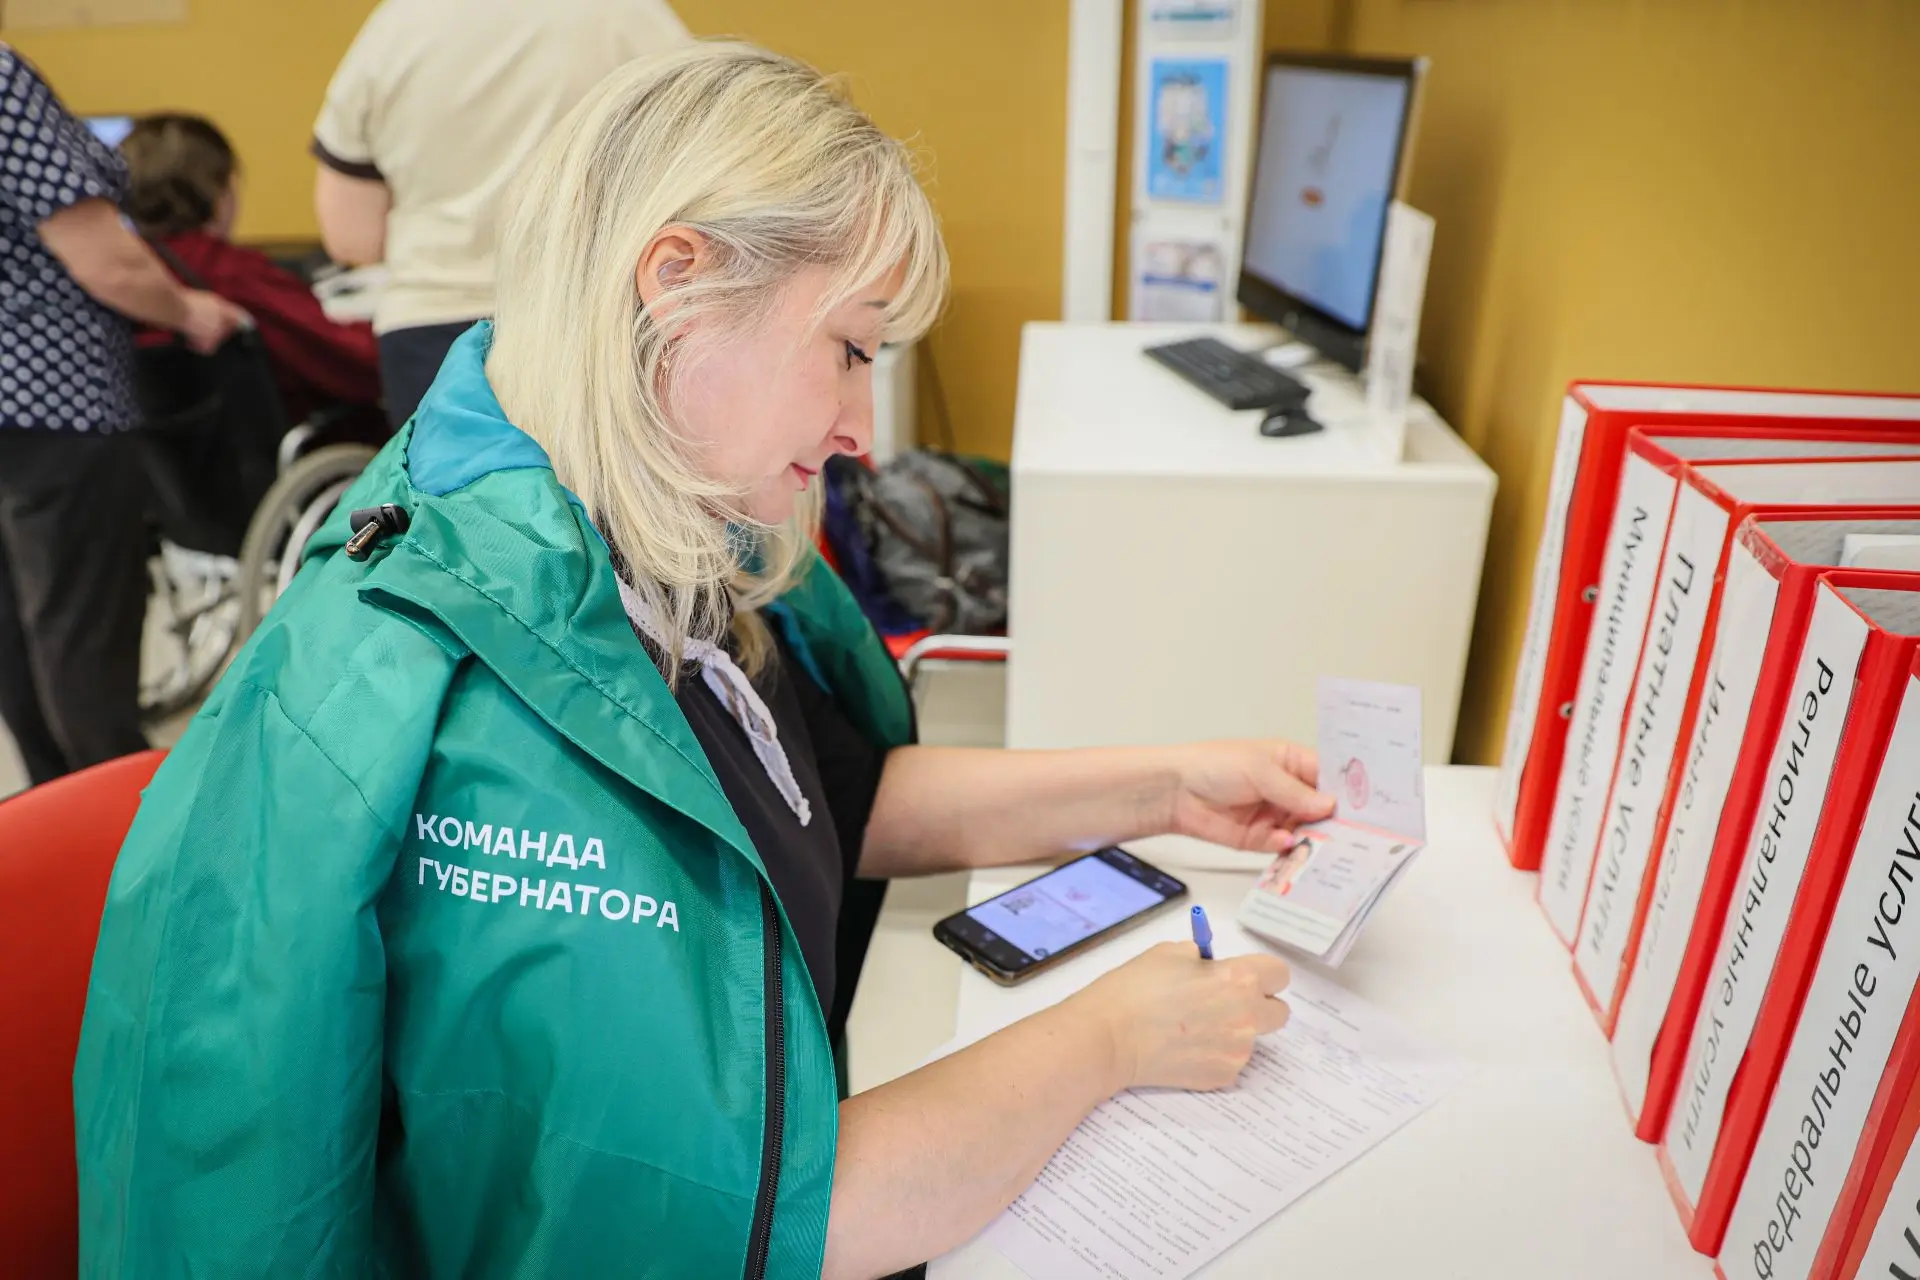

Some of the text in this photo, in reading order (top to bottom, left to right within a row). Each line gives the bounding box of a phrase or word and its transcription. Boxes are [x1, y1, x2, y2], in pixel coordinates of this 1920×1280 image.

[1577, 506, 1649, 787] Муниципальные
[1590, 552, 1695, 955] Платные услуги
[1683, 674, 1726, 811] Иные
[416, 814, 606, 870] КОМАНДА
[418, 857, 680, 932] ГУБЕРНАТОРА
[1682, 657, 1834, 1151] Региональные услуги
[1754, 792, 1920, 1280] Федеральные услуг
